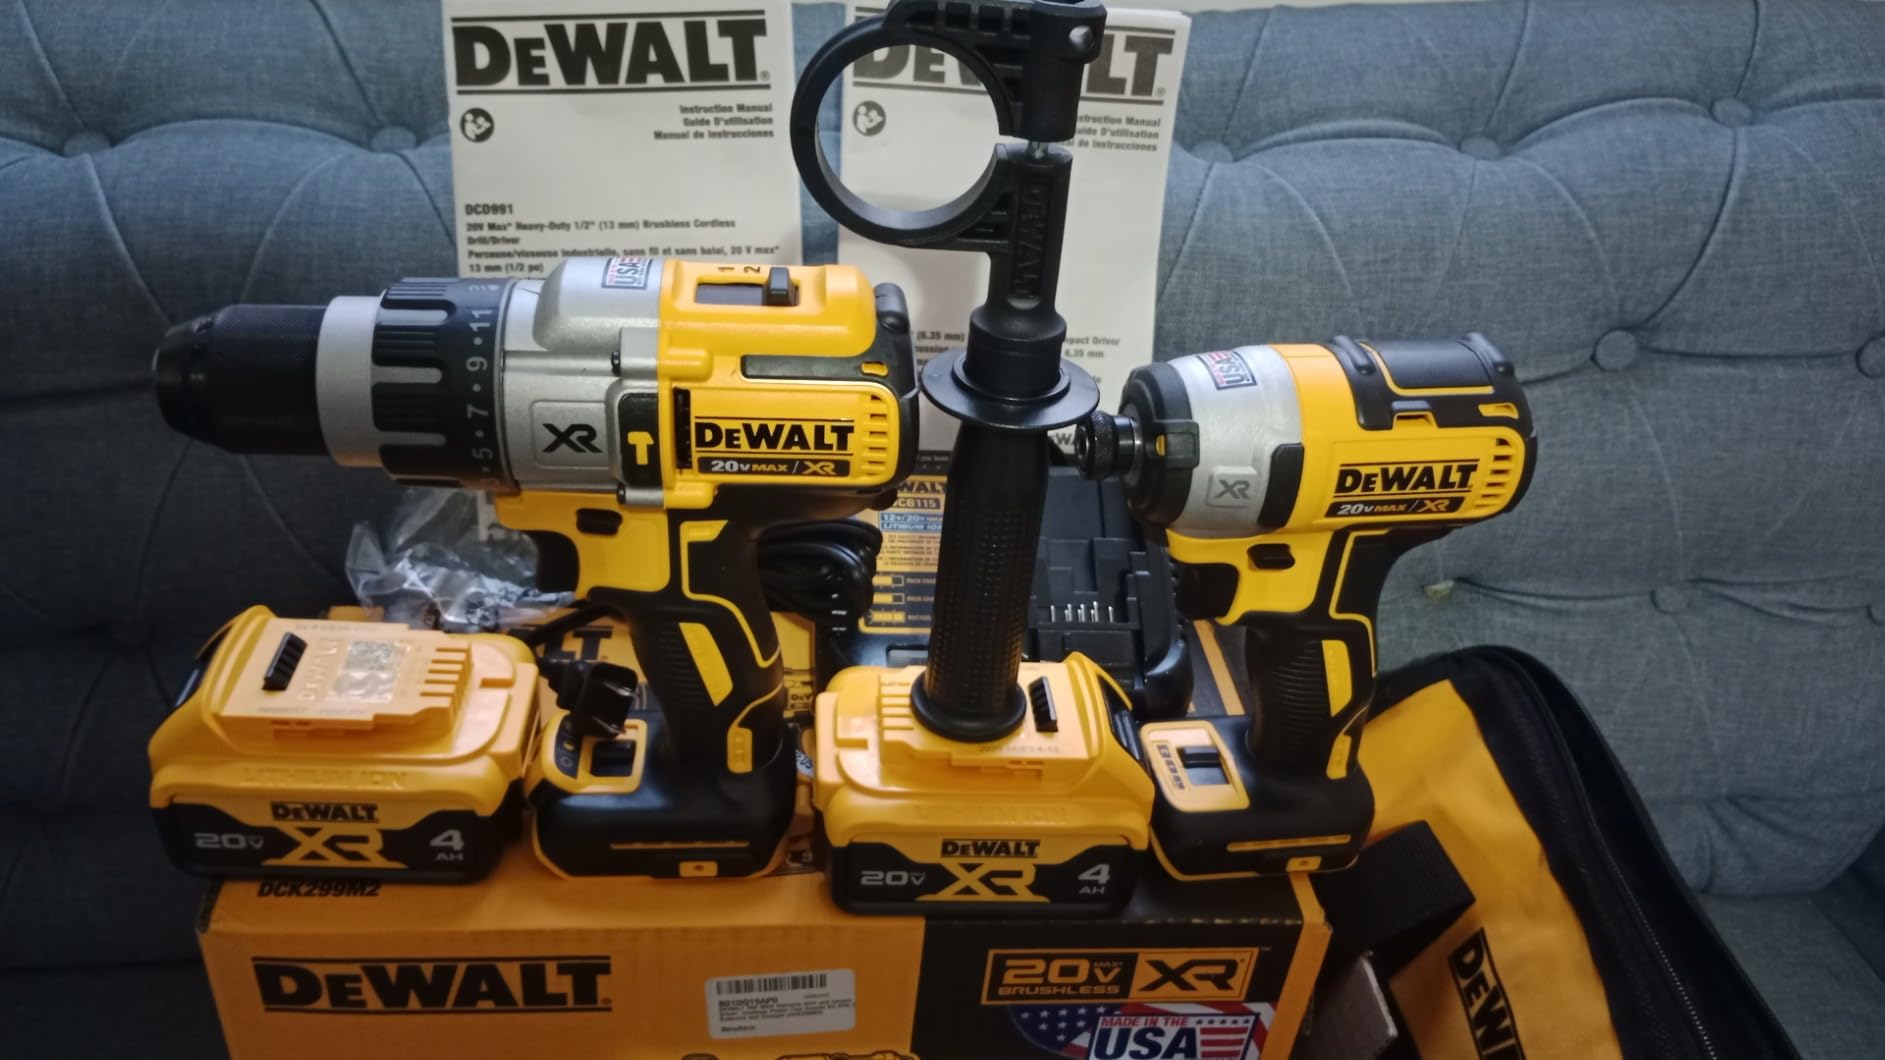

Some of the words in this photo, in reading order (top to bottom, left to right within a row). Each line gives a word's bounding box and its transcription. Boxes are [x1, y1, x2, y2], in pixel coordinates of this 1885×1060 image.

[452, 19, 767, 87] DEWALT
[679, 103, 733, 114] Instruction
[736, 102, 773, 112] Manual
[683, 117, 711, 127] Guide
[1125, 117, 1161, 128] Manual
[654, 130, 690, 140] Manual
[692, 130, 704, 139] de
[1076, 127, 1098, 136] uide
[1077, 139, 1089, 148] de
[465, 203, 513, 216] DCD991
[515, 221, 571, 232] Heavy-Duty
[599, 220, 615, 231] (13
[643, 219, 691, 229] Brushless
[694, 218, 736, 229] Cordless
[467, 235, 520, 245] Drill/Driver
[469, 263, 481, 273] 13
[615, 258, 639, 286] USA
[744, 266, 761, 274] 2
[468, 309, 494, 332] 11
[1092, 336, 1121, 347] Driver
[466, 356, 488, 371] 9
[1215, 356, 1246, 385] USA
[466, 403, 489, 419] 7
[542, 423, 603, 453] XR
[695, 421, 855, 452] DEWALT
[471, 447, 494, 461] 5
[802, 460, 837, 475] XR
[1334, 463, 1479, 494] DEWALT
[1215, 479, 1251, 500] XR
[1417, 499, 1450, 513] XR
[272, 803, 379, 822] DEWALT
[261, 824, 408, 869] XR
[430, 829, 465, 850] 4
[942, 839, 1041, 857] DEWALT
[1078, 864, 1110, 884] 4
[257, 880, 382, 898] DCK299M2
[915, 862, 1050, 902] XR
[1079, 886, 1105, 894] AH
[1138, 959, 1240, 991] XR
[253, 962, 612, 1009] DEWALT
[998, 984, 1121, 996] BRUSHLESS
[1100, 1017, 1141, 1027] MADE
[1144, 1016, 1159, 1027] IN
[1161, 1016, 1189, 1027] THE
[1093, 1026, 1198, 1060] USA
